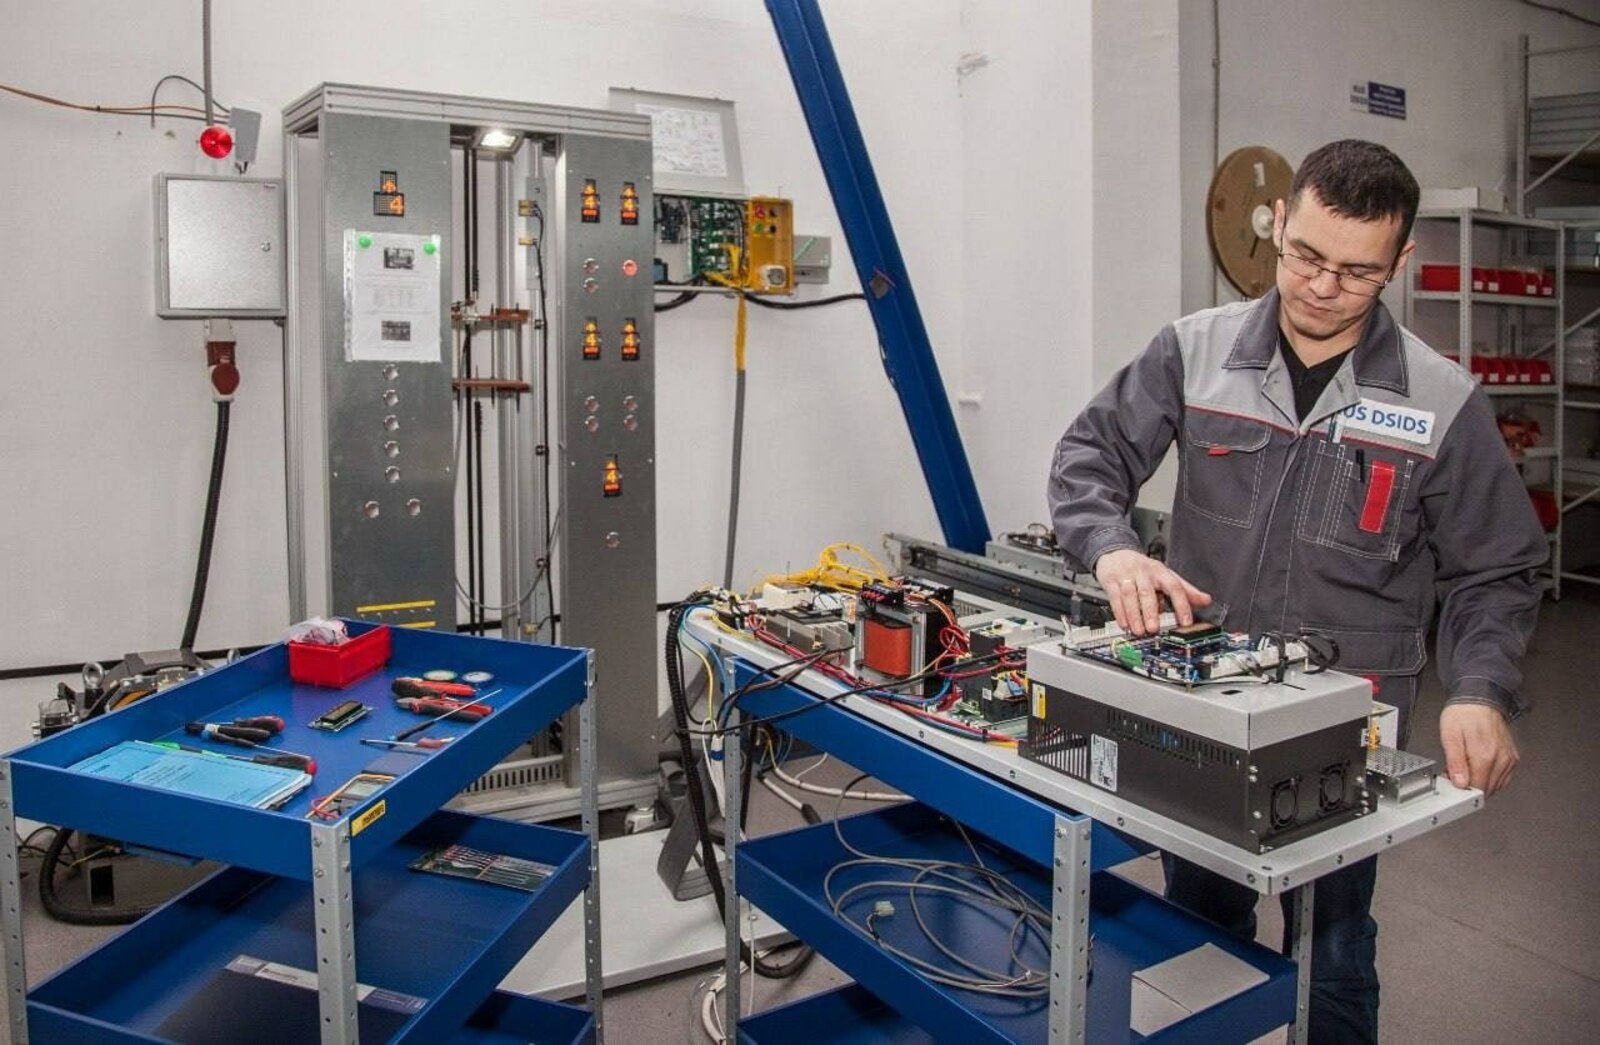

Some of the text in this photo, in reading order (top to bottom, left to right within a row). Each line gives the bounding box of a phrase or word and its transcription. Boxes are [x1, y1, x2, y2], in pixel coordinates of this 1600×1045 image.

[390, 195, 404, 214] 4
[1339, 403, 1427, 434] US DSIDS
